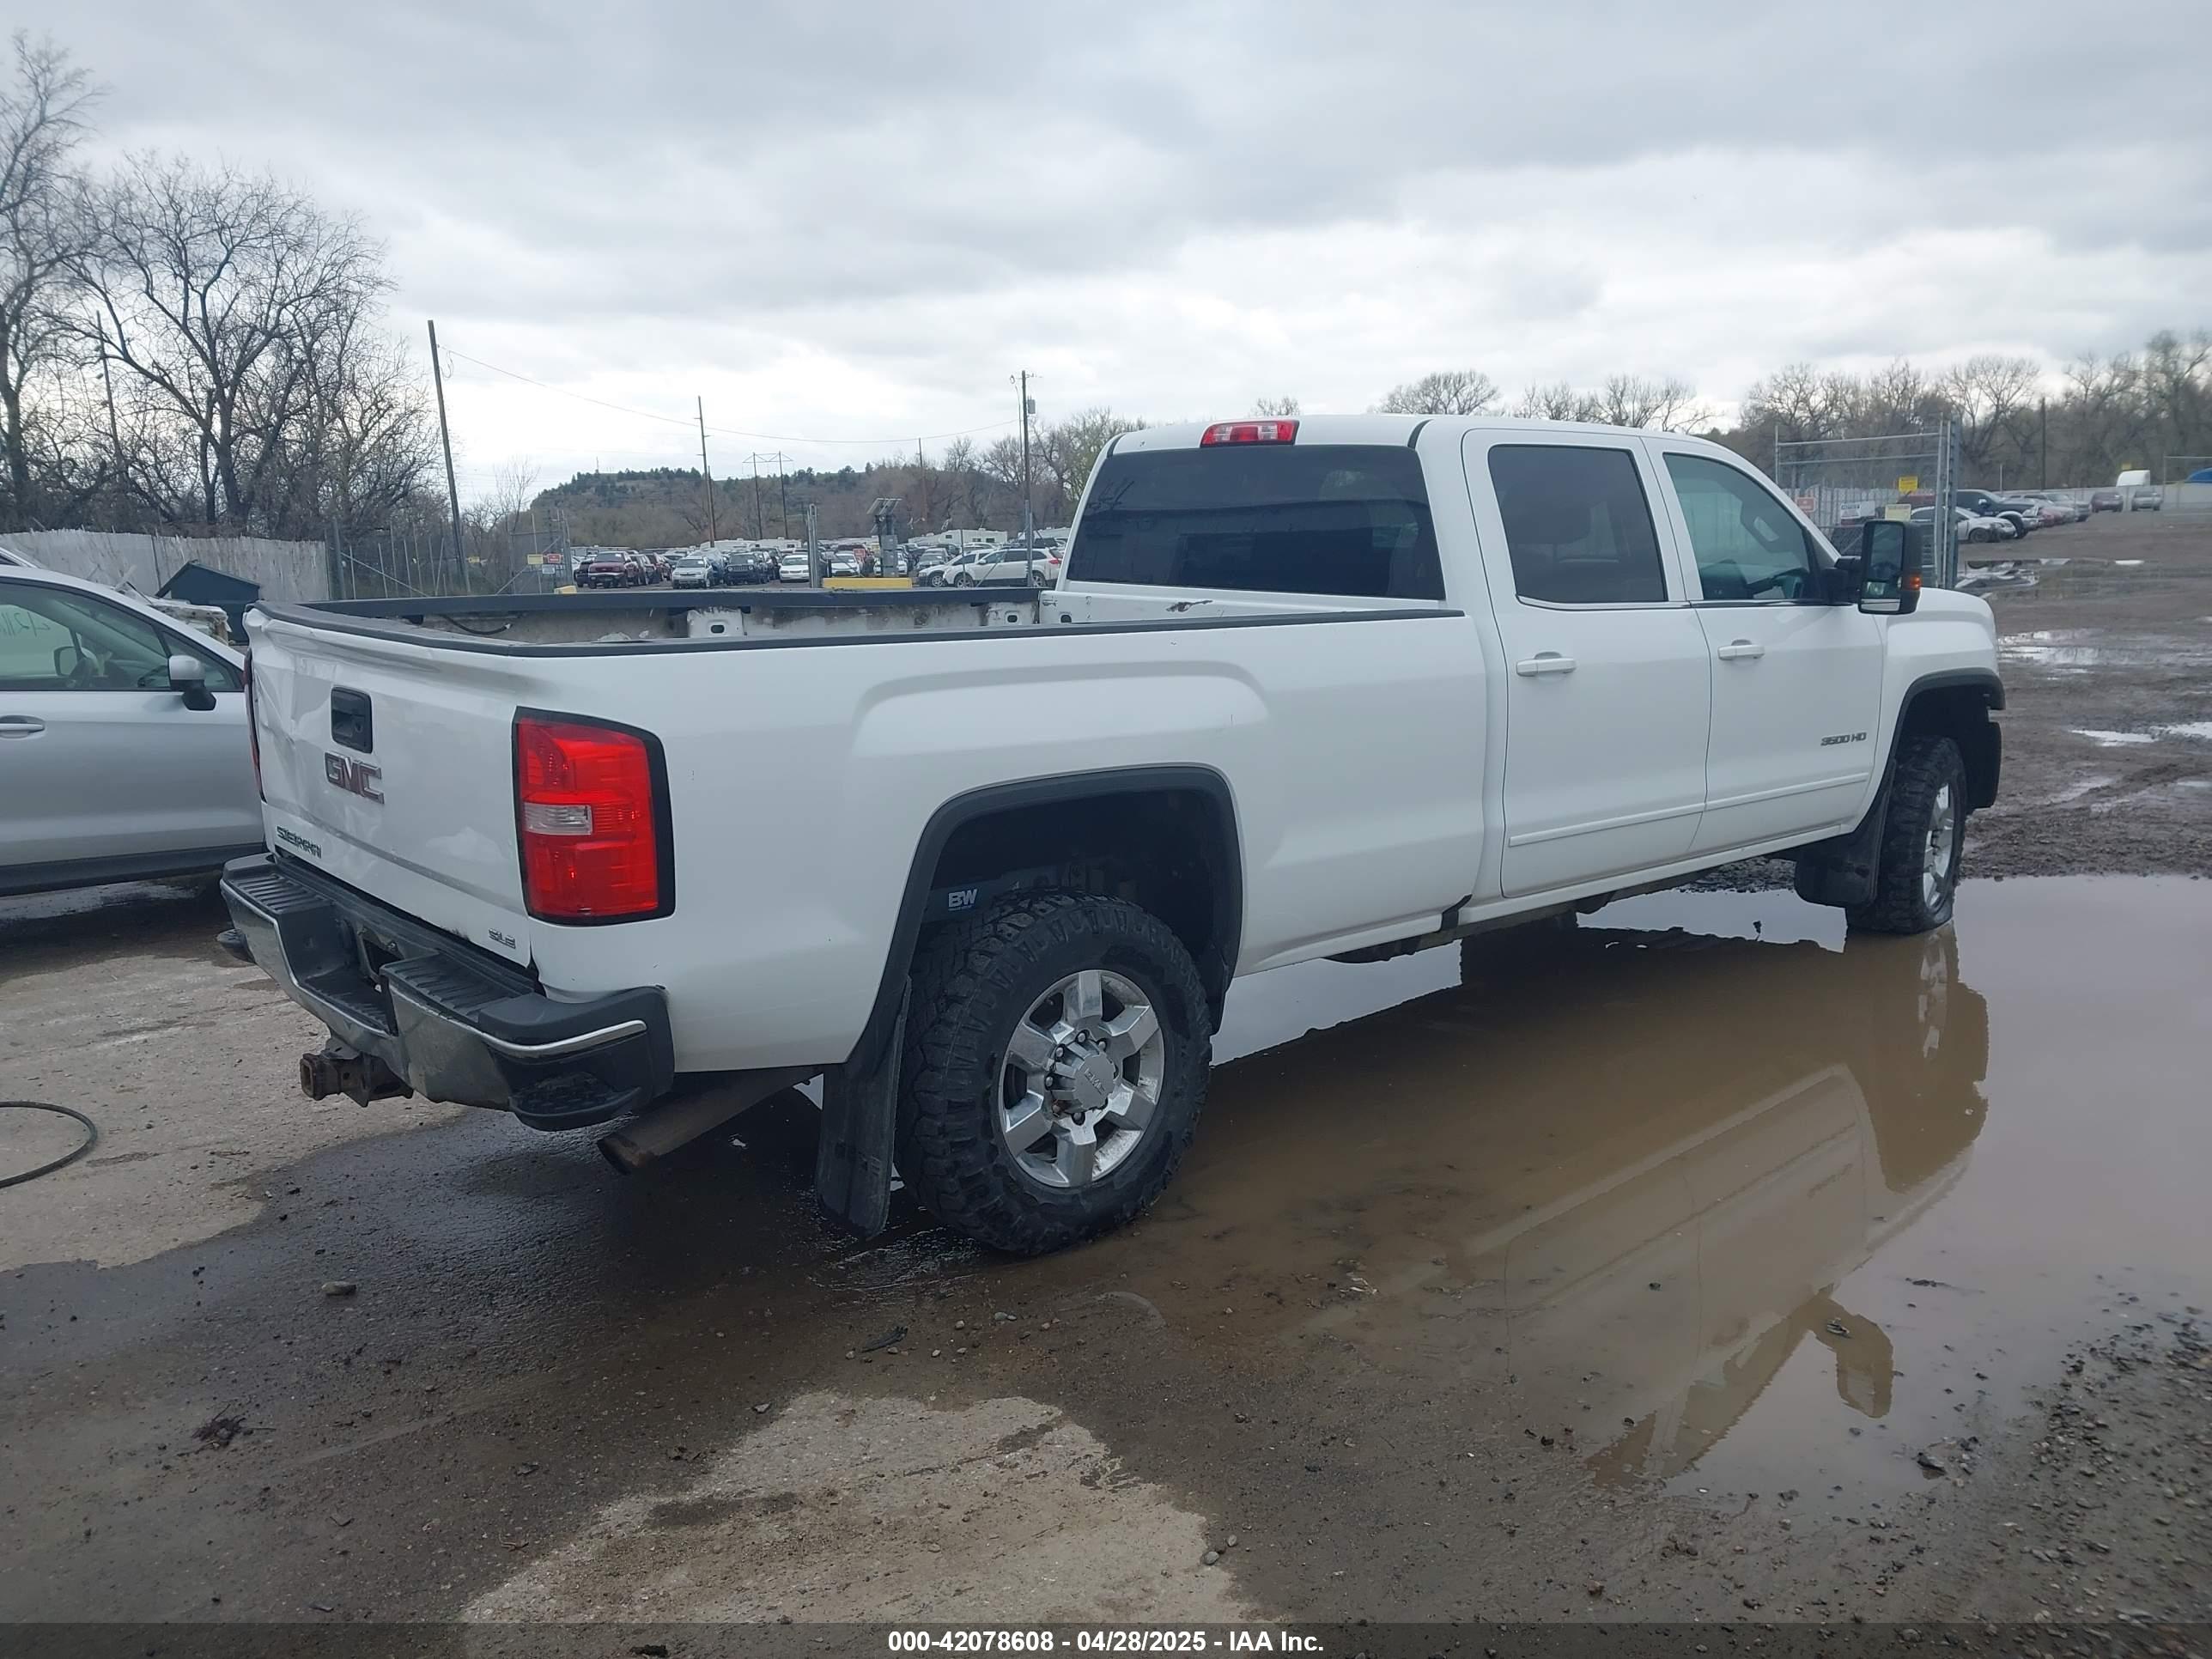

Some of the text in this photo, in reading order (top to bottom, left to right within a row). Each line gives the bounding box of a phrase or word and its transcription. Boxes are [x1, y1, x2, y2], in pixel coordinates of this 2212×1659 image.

[1820, 732, 1867, 746] 3500 HD
[325, 752, 385, 804] GMC
[276, 825, 322, 859] SIERRA
[489, 928, 516, 950] SLE
